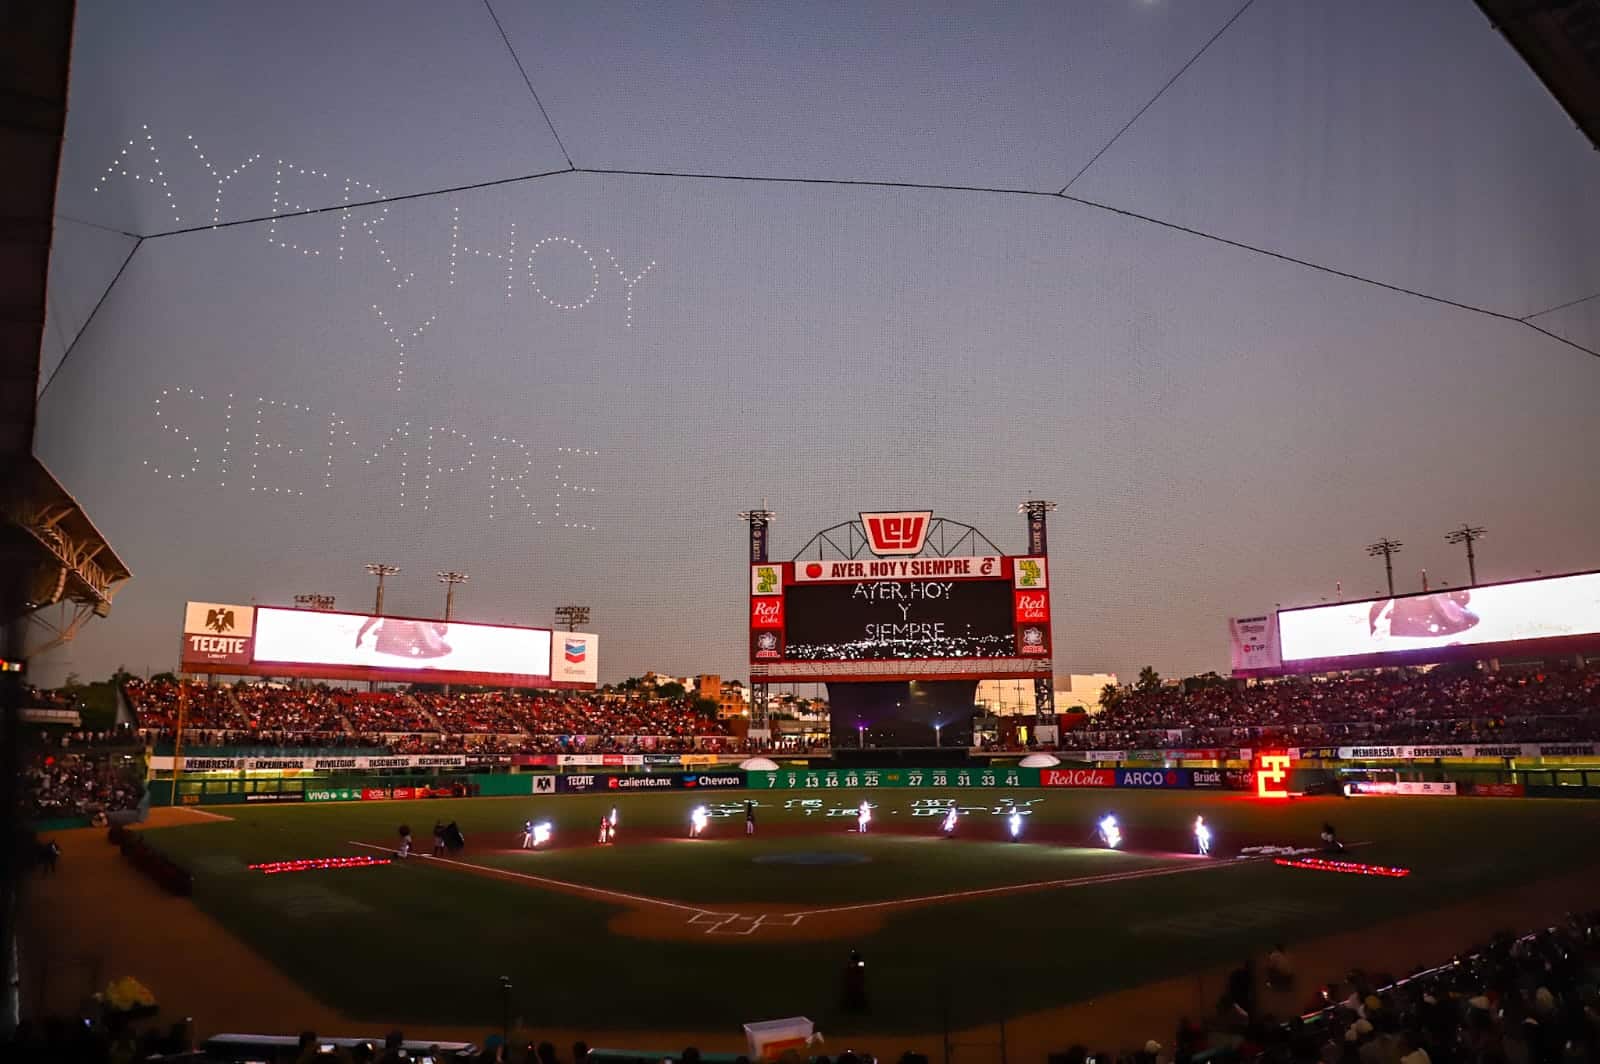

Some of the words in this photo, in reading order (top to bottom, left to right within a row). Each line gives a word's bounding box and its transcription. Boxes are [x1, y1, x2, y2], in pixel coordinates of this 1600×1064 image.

[449, 206, 657, 328] HOY
[370, 304, 437, 392] Y
[142, 385, 599, 531] SIEMPRE
[831, 562, 867, 577] AYER,
[870, 561, 897, 577] HOY
[900, 561, 908, 576] Y
[911, 559, 970, 576] SIEMPRE
[910, 581, 953, 600] HOY
[754, 601, 780, 615] Red
[1019, 595, 1045, 609] Red
[760, 614, 778, 624] Cola
[898, 603, 912, 621] Y
[1024, 608, 1043, 618] Cola
[864, 623, 945, 642] SIEMPRE
[189, 635, 248, 654] TECATE
[255, 760, 304, 769] EXPERIENCIAS
[315, 759, 357, 769] PRIVILEGIOS
[369, 758, 410, 768] DESCUENTOS
[567, 775, 595, 786] TECATE
[618, 776, 672, 788] caliente.mx
[699, 775, 740, 786] Chevron
[768, 777, 776, 788] 7
[788, 777, 796, 787] 9
[805, 777, 819, 787] 13
[825, 776, 839, 787] 16
[845, 776, 858, 787] 18
[865, 776, 879, 786] 25
[909, 775, 922, 786] 27
[933, 775, 947, 786] 28
[957, 775, 970, 786] 31
[981, 775, 995, 786] 33
[1005, 775, 1020, 786] 41
[1048, 770, 1072, 785] Red
[1077, 770, 1104, 785] Cola
[1123, 772, 1164, 785] ARCO
